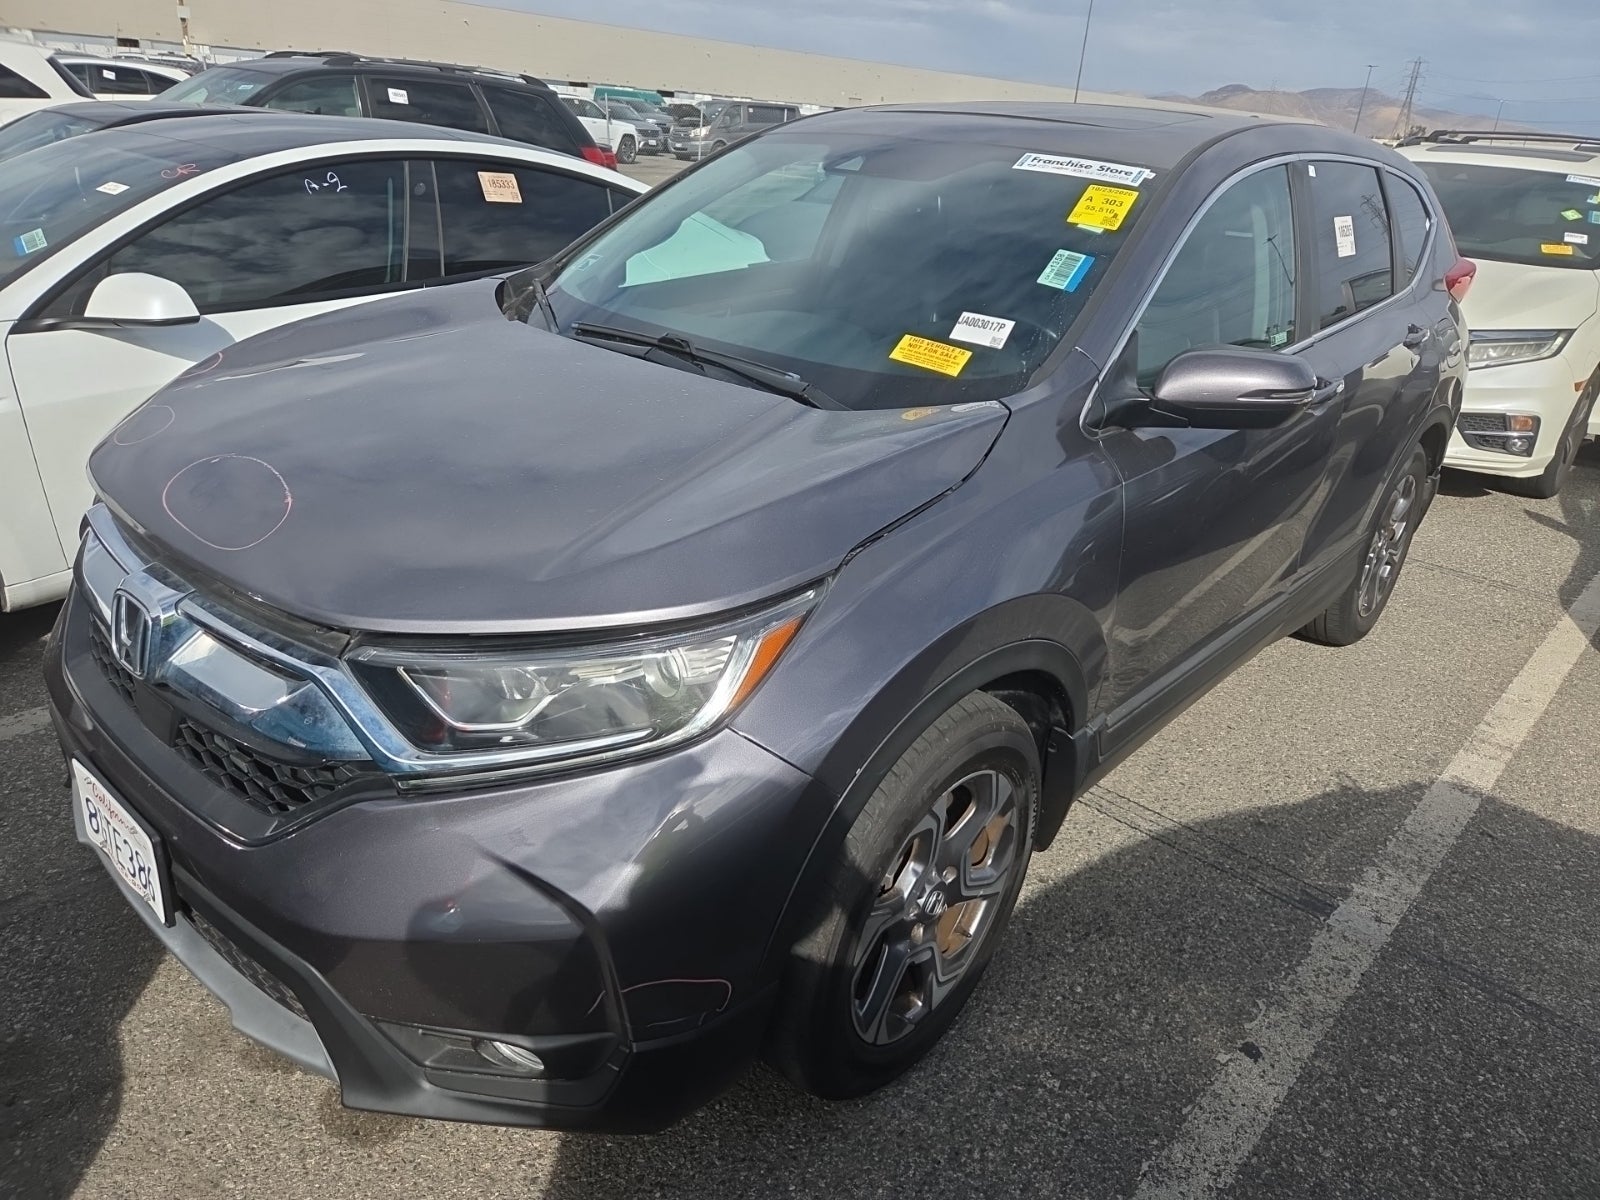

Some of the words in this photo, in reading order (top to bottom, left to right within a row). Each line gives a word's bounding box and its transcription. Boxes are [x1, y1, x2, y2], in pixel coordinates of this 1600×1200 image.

[1031, 156, 1093, 170] Franchise
[1096, 165, 1134, 177] Store
[1101, 197, 1124, 208] 303
[957, 315, 1007, 333] JA003017P
[907, 342, 922, 350] NOT
[923, 346, 938, 355] FOR
[939, 351, 960, 360] SALE
[908, 337, 923, 345] THIS
[926, 341, 956, 353] VEHICLE
